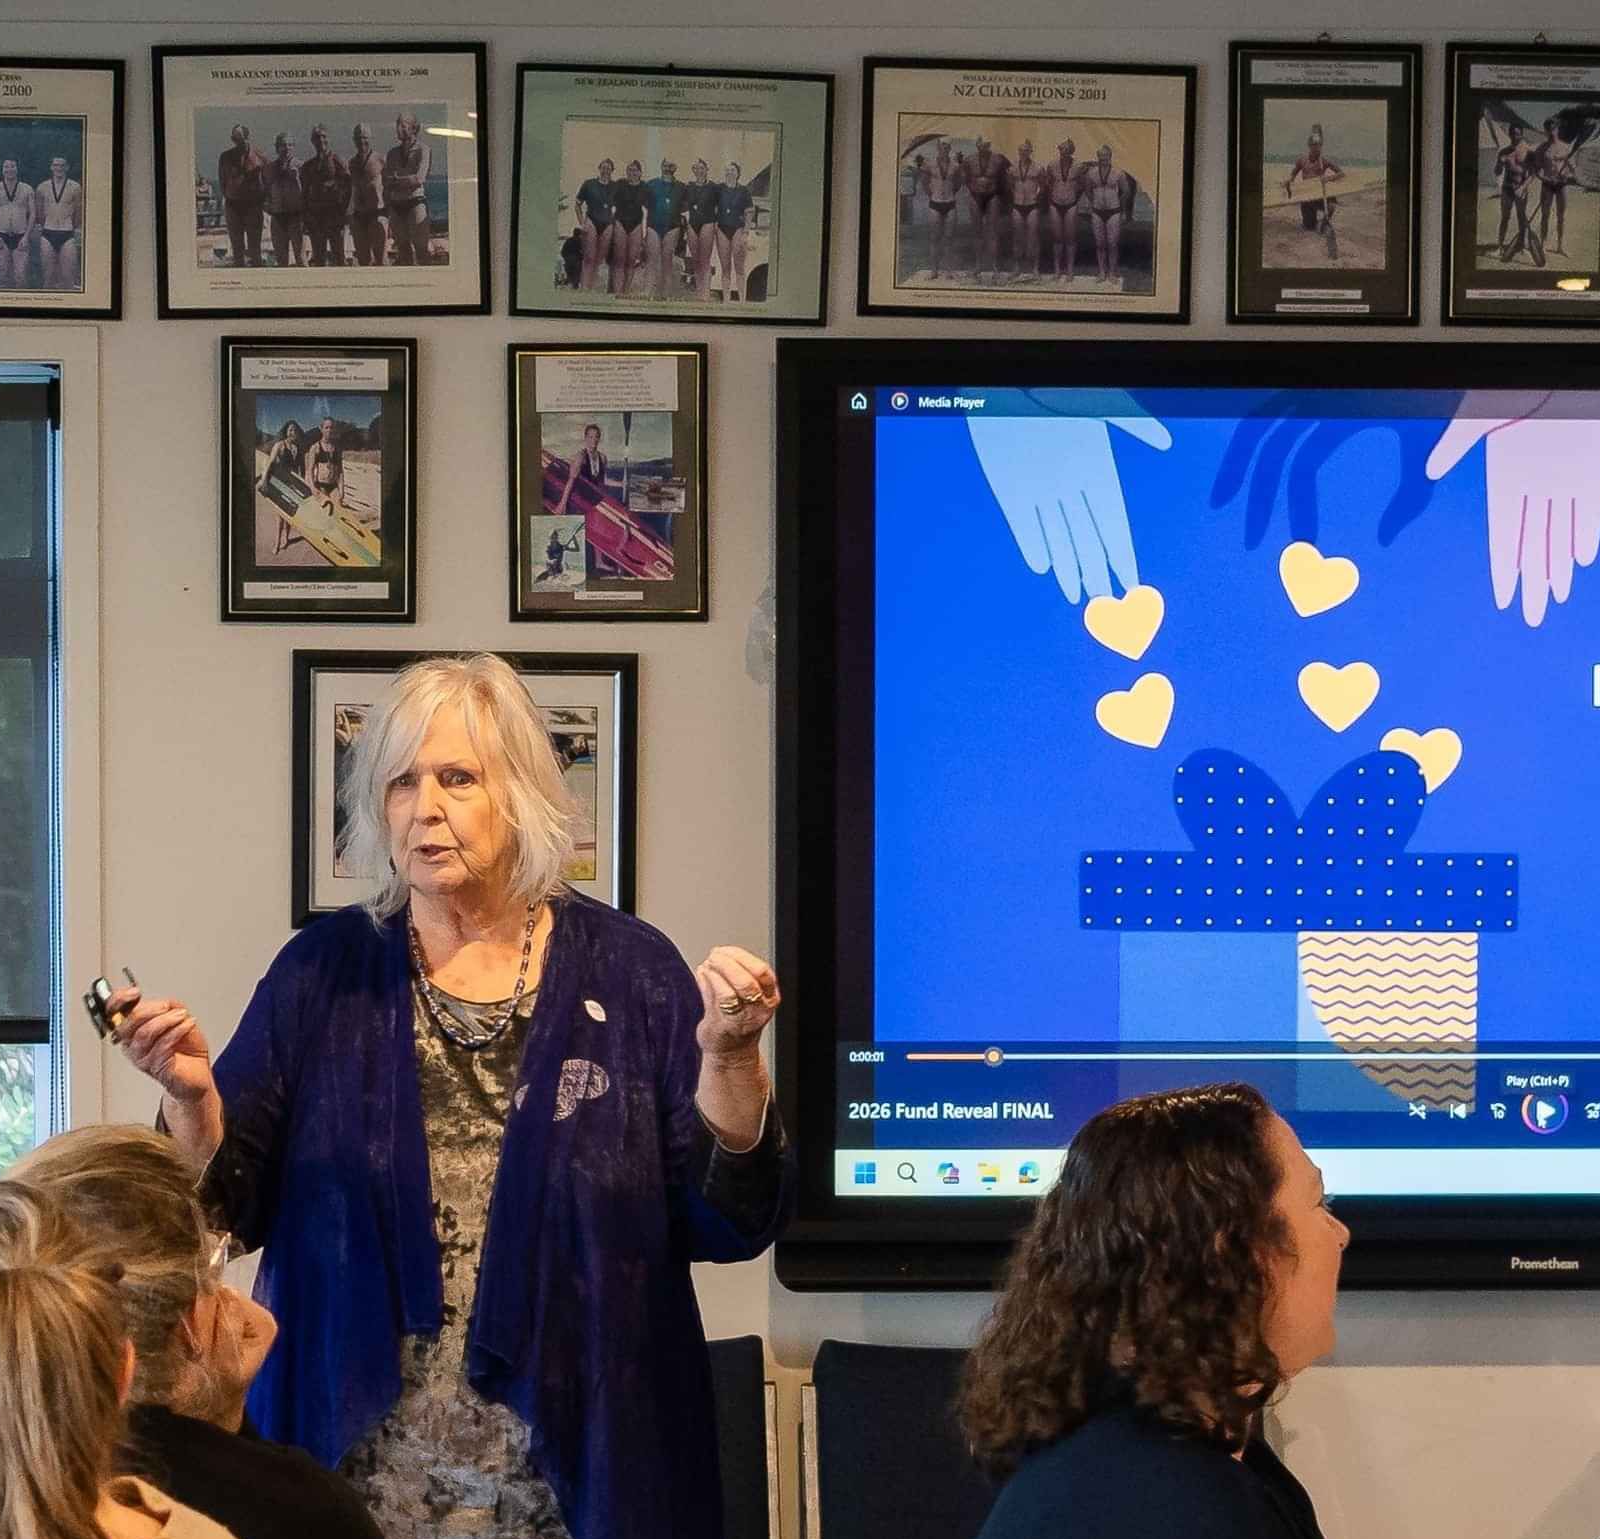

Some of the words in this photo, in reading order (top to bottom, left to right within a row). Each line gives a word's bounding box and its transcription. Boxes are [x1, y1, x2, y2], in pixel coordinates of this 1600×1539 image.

[2, 85, 32, 96] 2000
[954, 84, 975, 97] NZ
[978, 84, 1075, 99] CHAMPIONS
[1078, 88, 1106, 100] 2001
[918, 396, 951, 408] Media
[953, 396, 985, 410] Player
[849, 1051, 884, 1062] 0:00:01
[1506, 1075, 1528, 1088] Play
[1529, 1075, 1569, 1088] (Ctrl+P)
[848, 1102, 891, 1119] 2026
[895, 1102, 938, 1119] Fund
[943, 1102, 998, 1119] Reveal
[1003, 1102, 1054, 1119] FINAL
[1511, 1256, 1579, 1270] Promethean
